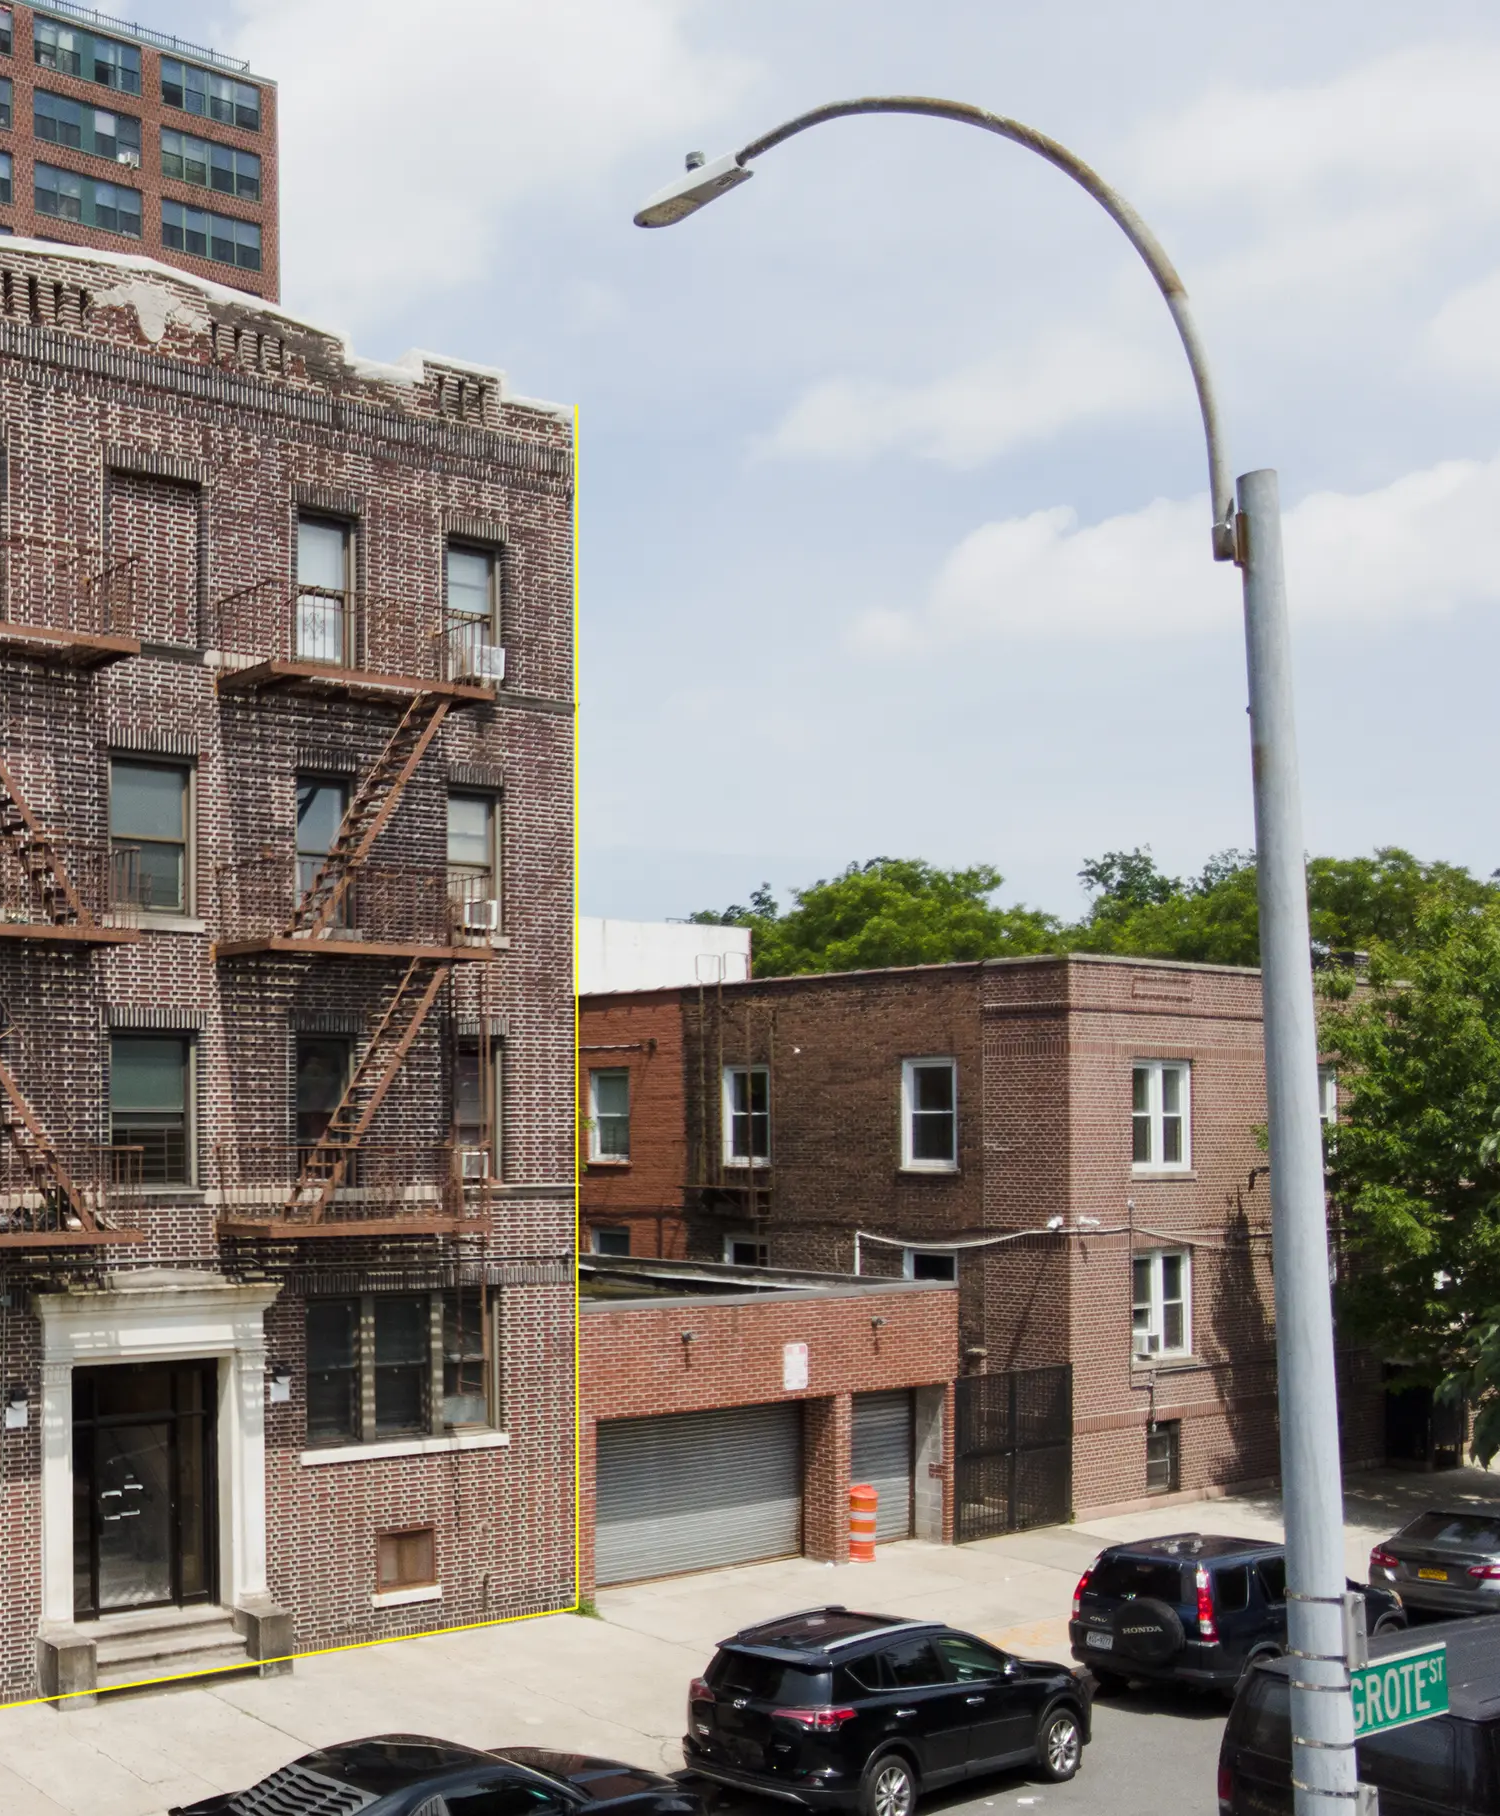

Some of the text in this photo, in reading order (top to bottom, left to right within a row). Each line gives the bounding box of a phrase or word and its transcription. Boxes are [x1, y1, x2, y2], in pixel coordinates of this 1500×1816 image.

[1122, 1625, 1163, 1634] HONDA
[1351, 1656, 1444, 1729] GROTE ST
